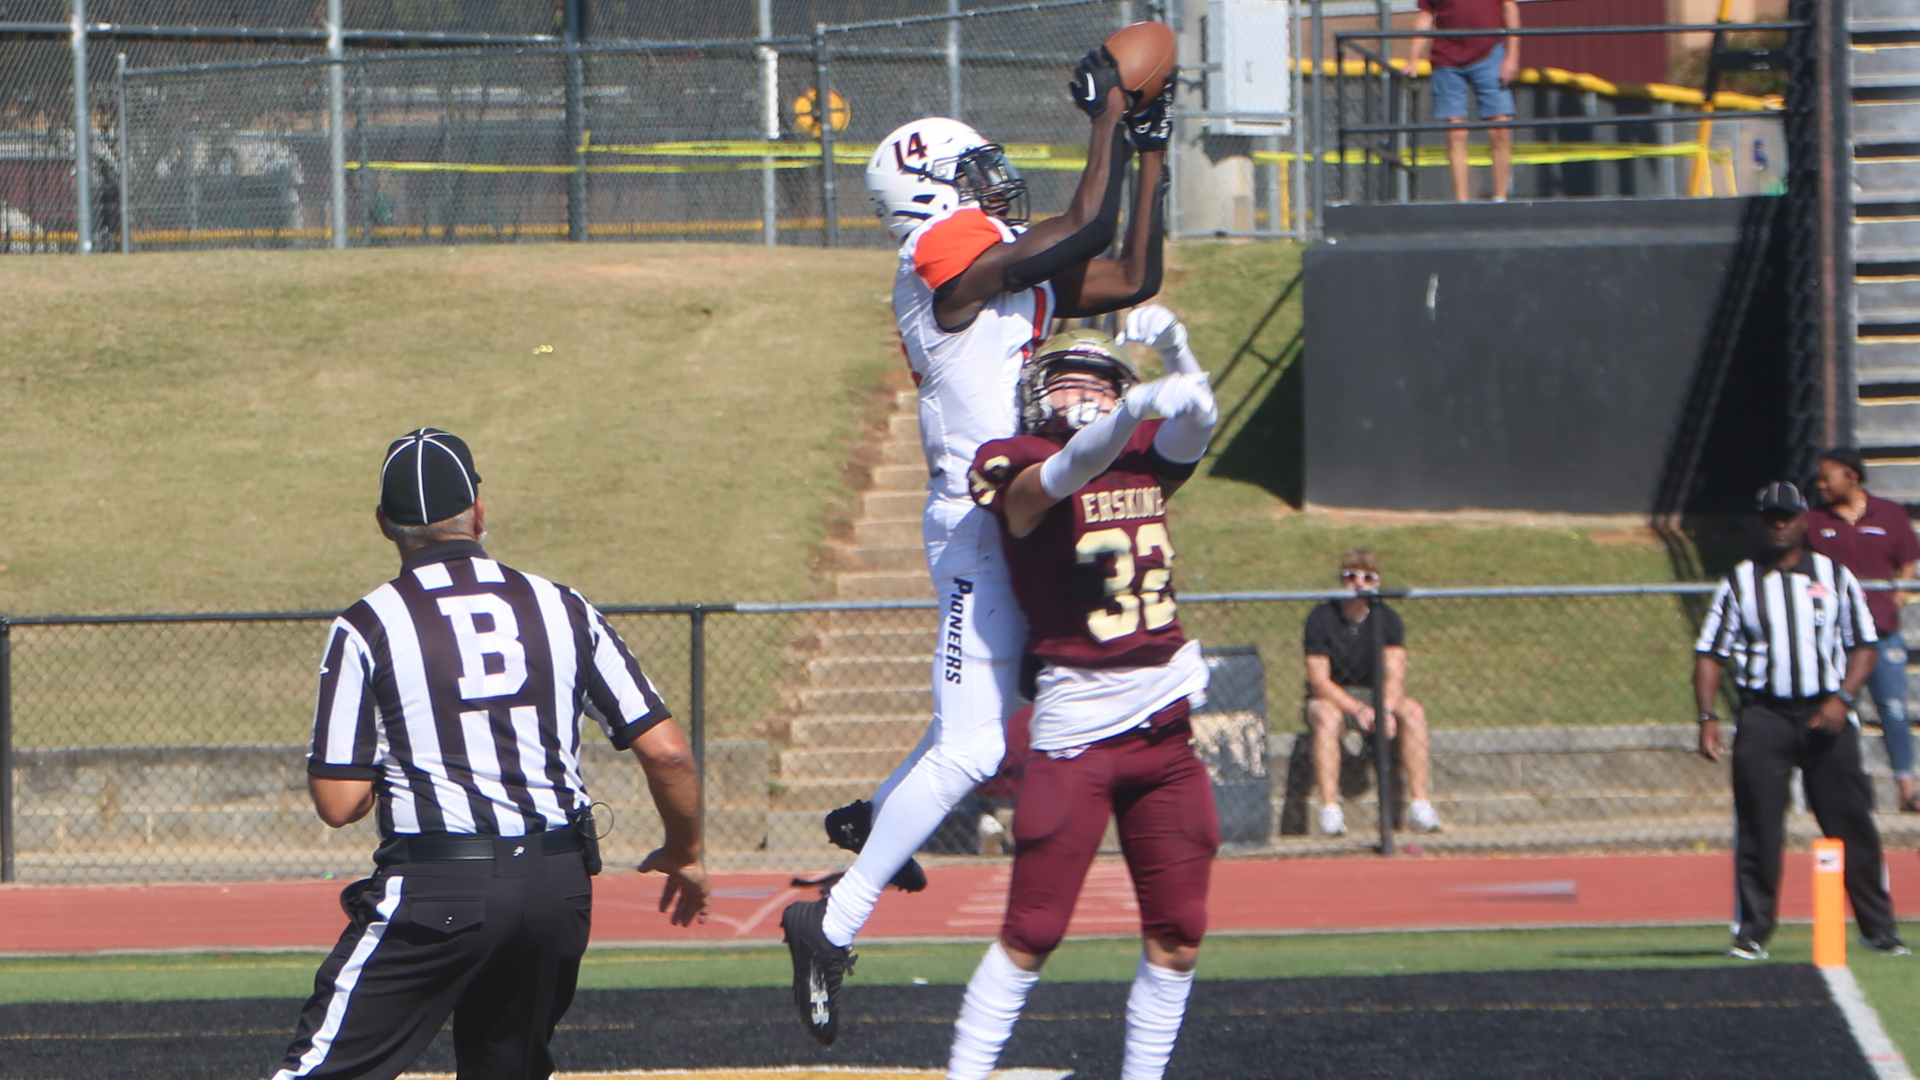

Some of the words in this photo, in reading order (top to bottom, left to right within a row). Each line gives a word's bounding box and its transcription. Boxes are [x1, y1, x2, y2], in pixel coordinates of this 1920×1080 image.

[892, 131, 928, 170] 14
[1080, 487, 1166, 523] ERSKINE
[944, 576, 974, 684] PIONEERS
[1075, 523, 1178, 643] 32
[436, 593, 528, 699] B
